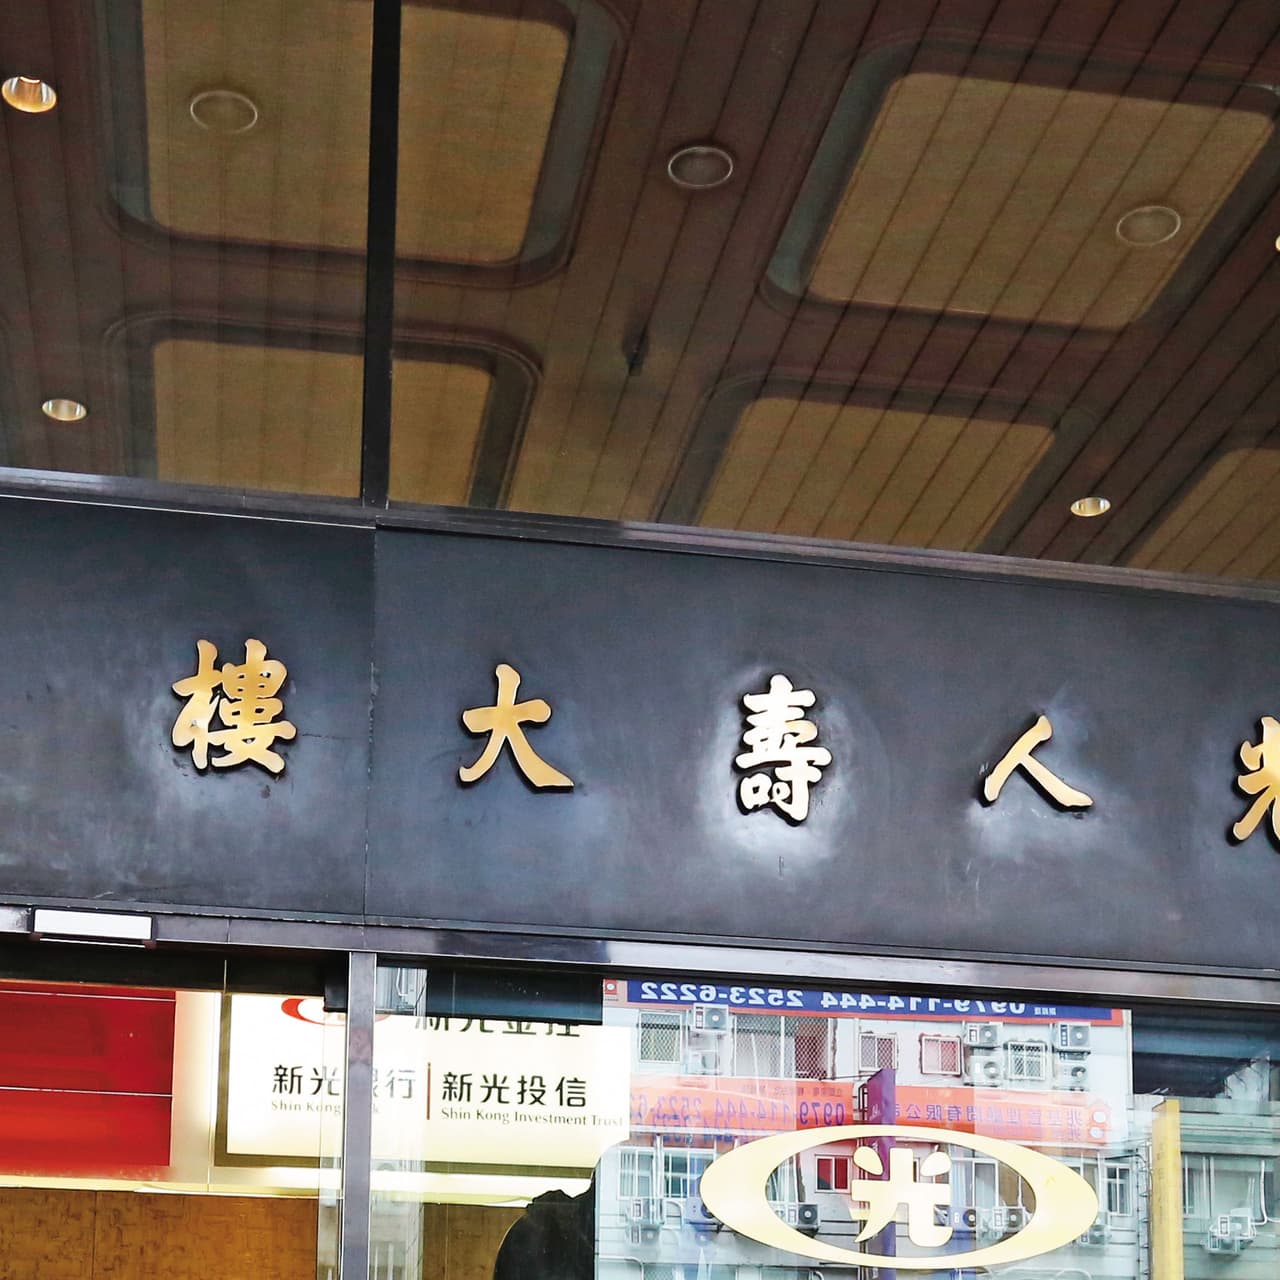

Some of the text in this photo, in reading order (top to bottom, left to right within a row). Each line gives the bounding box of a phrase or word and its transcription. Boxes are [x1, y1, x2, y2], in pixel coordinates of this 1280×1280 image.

[442, 1072, 587, 1107] 新光投信
[272, 1100, 301, 1112] Shin
[441, 1108, 624, 1127] Shin Kong Investment Trust
